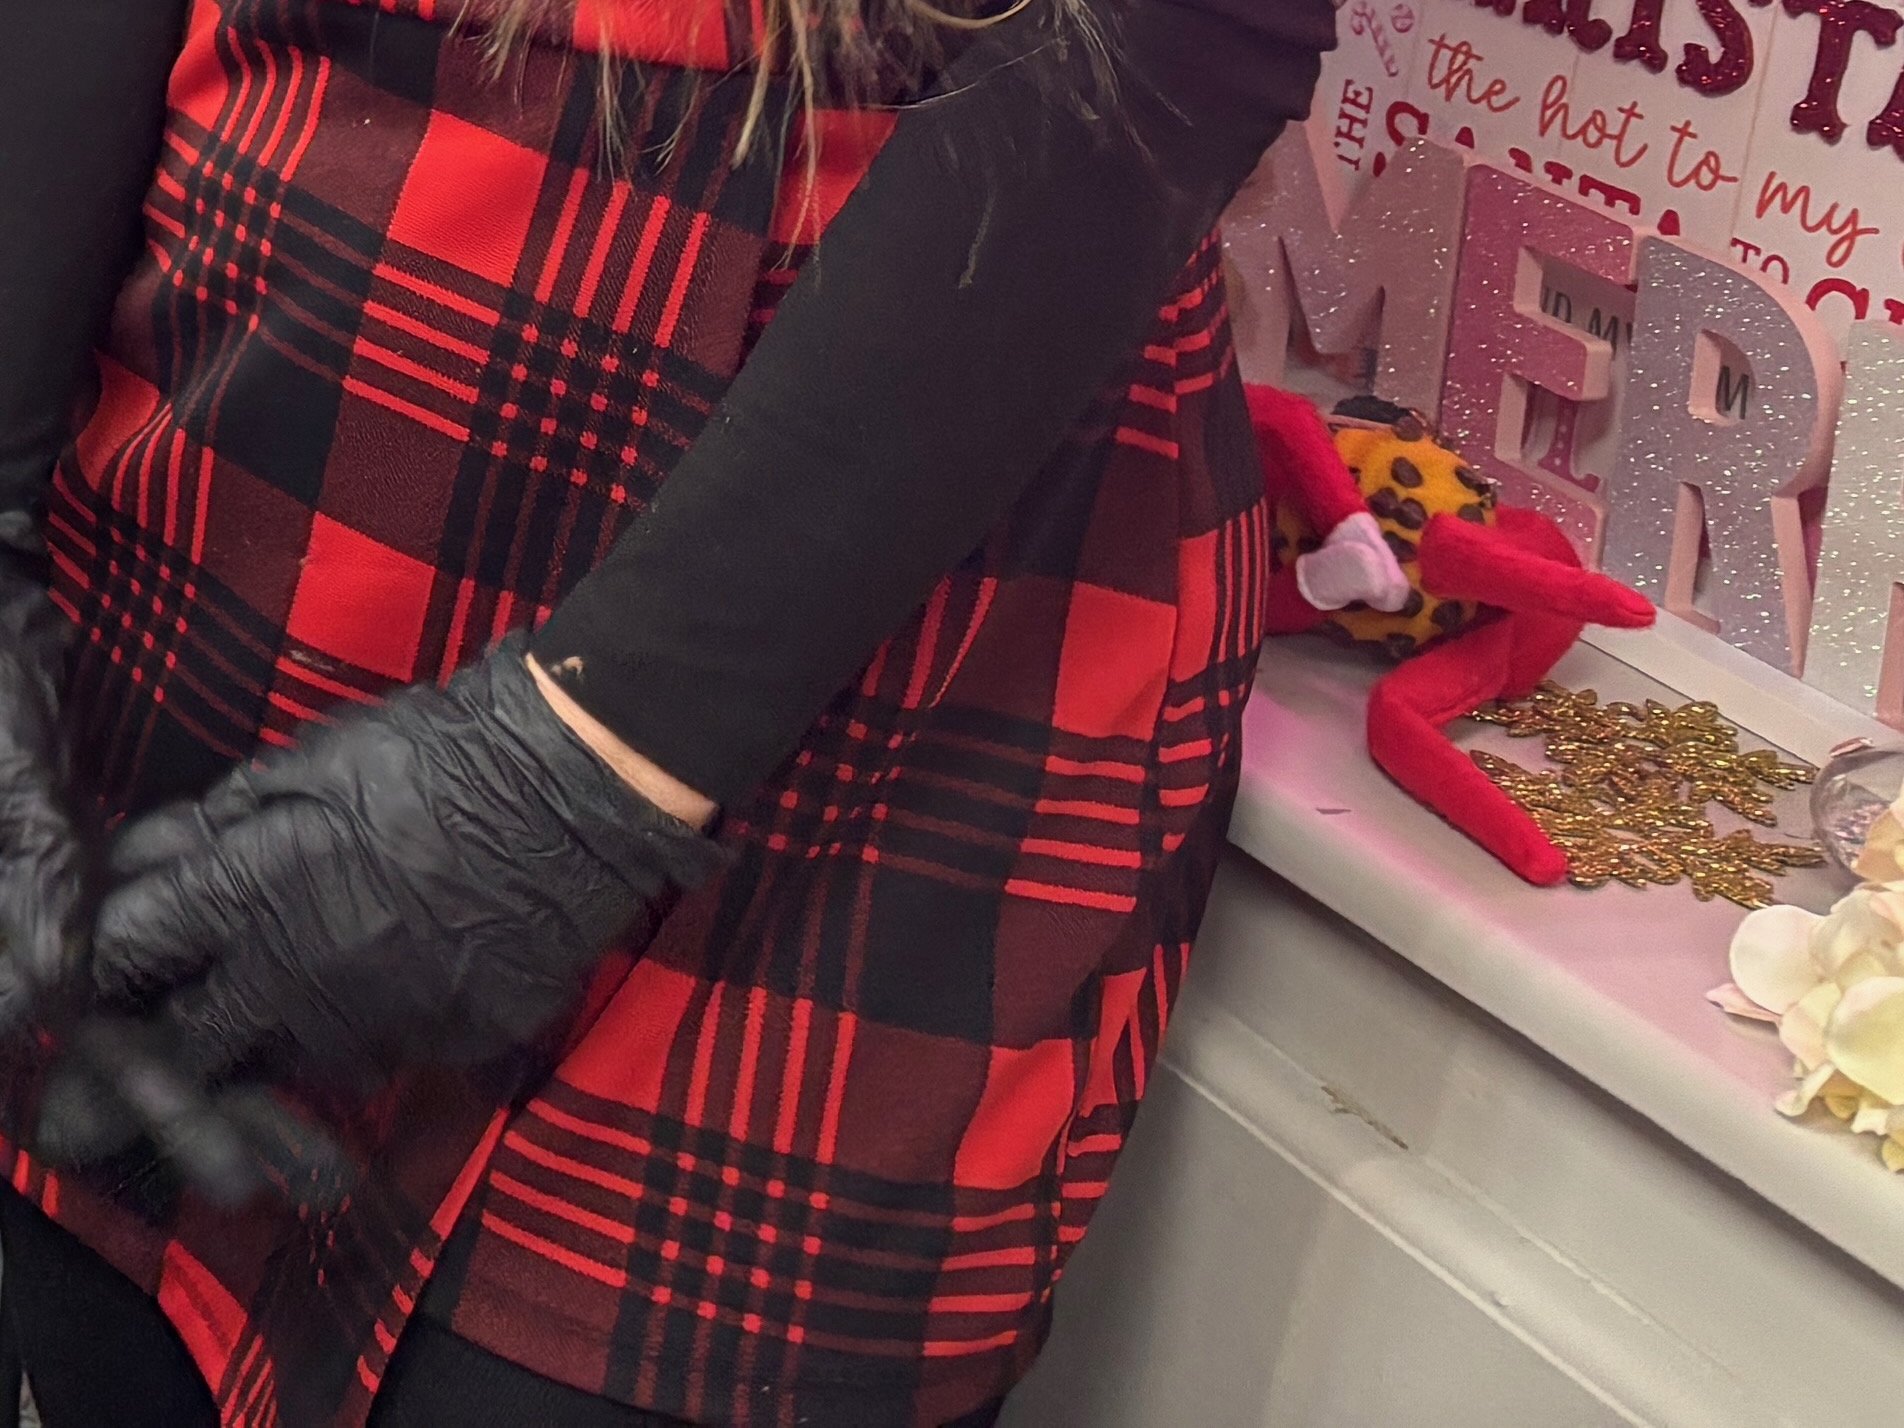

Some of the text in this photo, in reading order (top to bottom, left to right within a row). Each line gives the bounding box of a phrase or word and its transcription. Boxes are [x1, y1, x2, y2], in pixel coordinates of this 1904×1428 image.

[1427, 32, 1521, 112] the
[1538, 75, 1648, 169] hot
[1666, 118, 1739, 191] to
[1754, 171, 1880, 267] my
